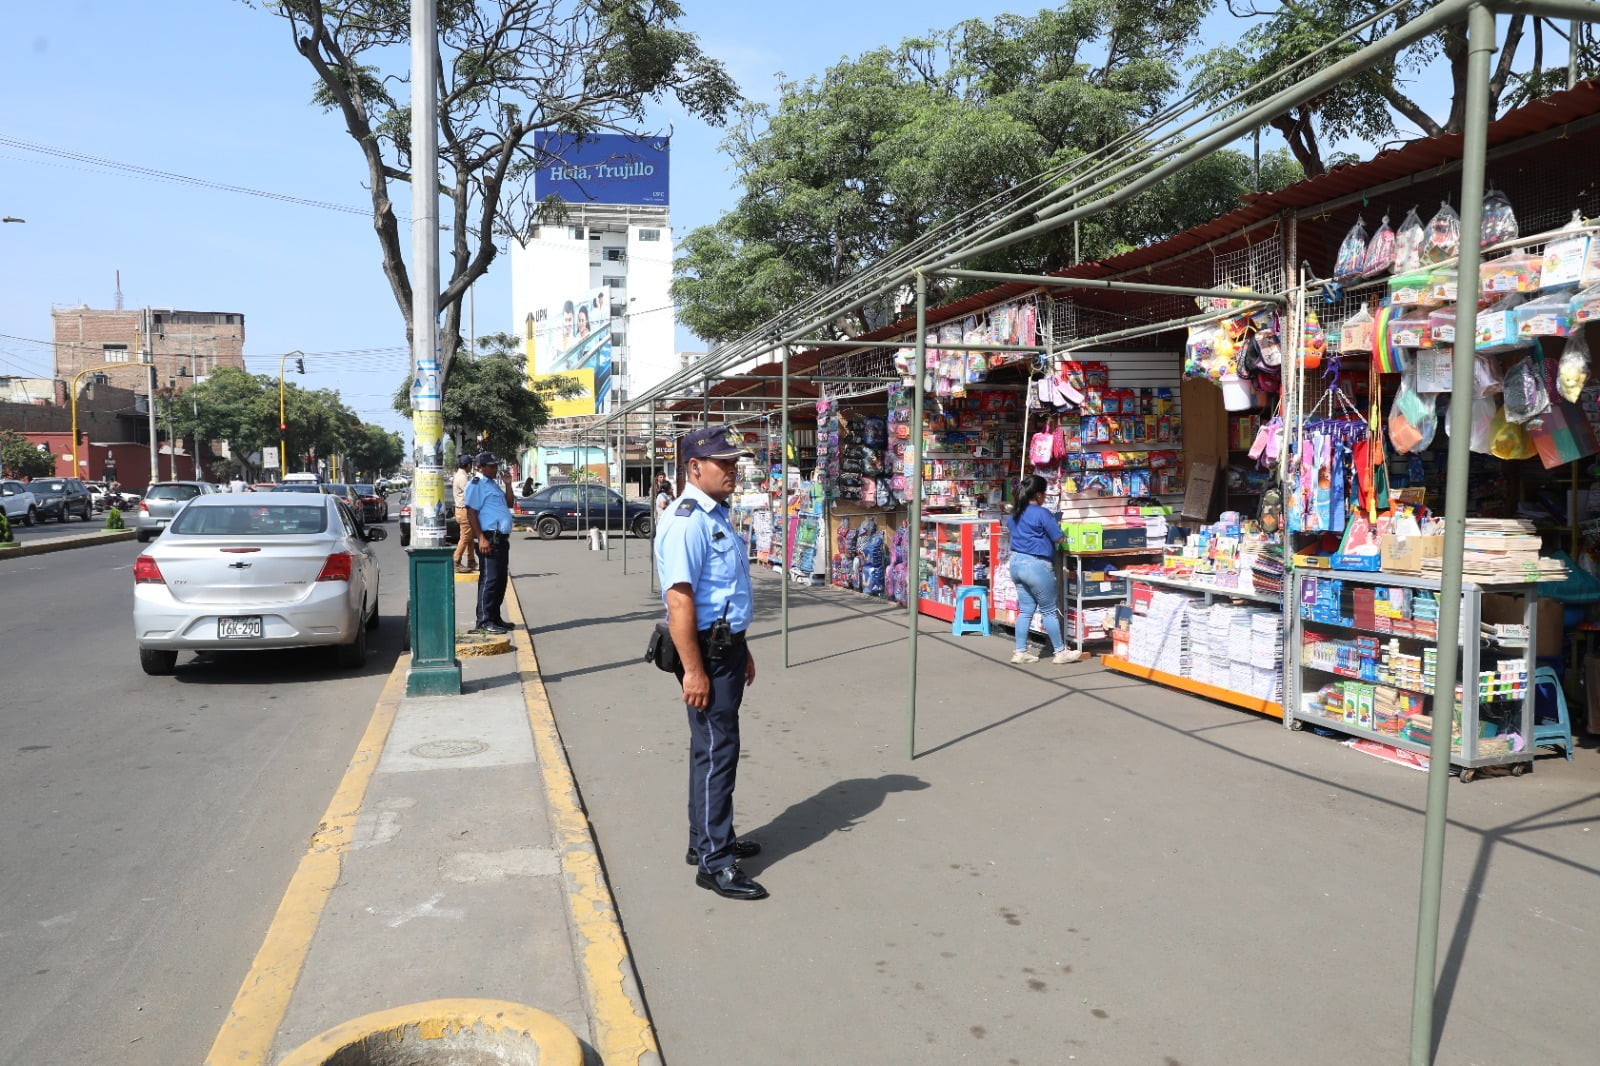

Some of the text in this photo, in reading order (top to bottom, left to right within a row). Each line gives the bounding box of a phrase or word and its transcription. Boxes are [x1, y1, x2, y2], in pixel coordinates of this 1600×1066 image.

[596, 162, 654, 179] Trujillo
[535, 308, 548, 323] UPN
[221, 622, 260, 635] T6K-290
